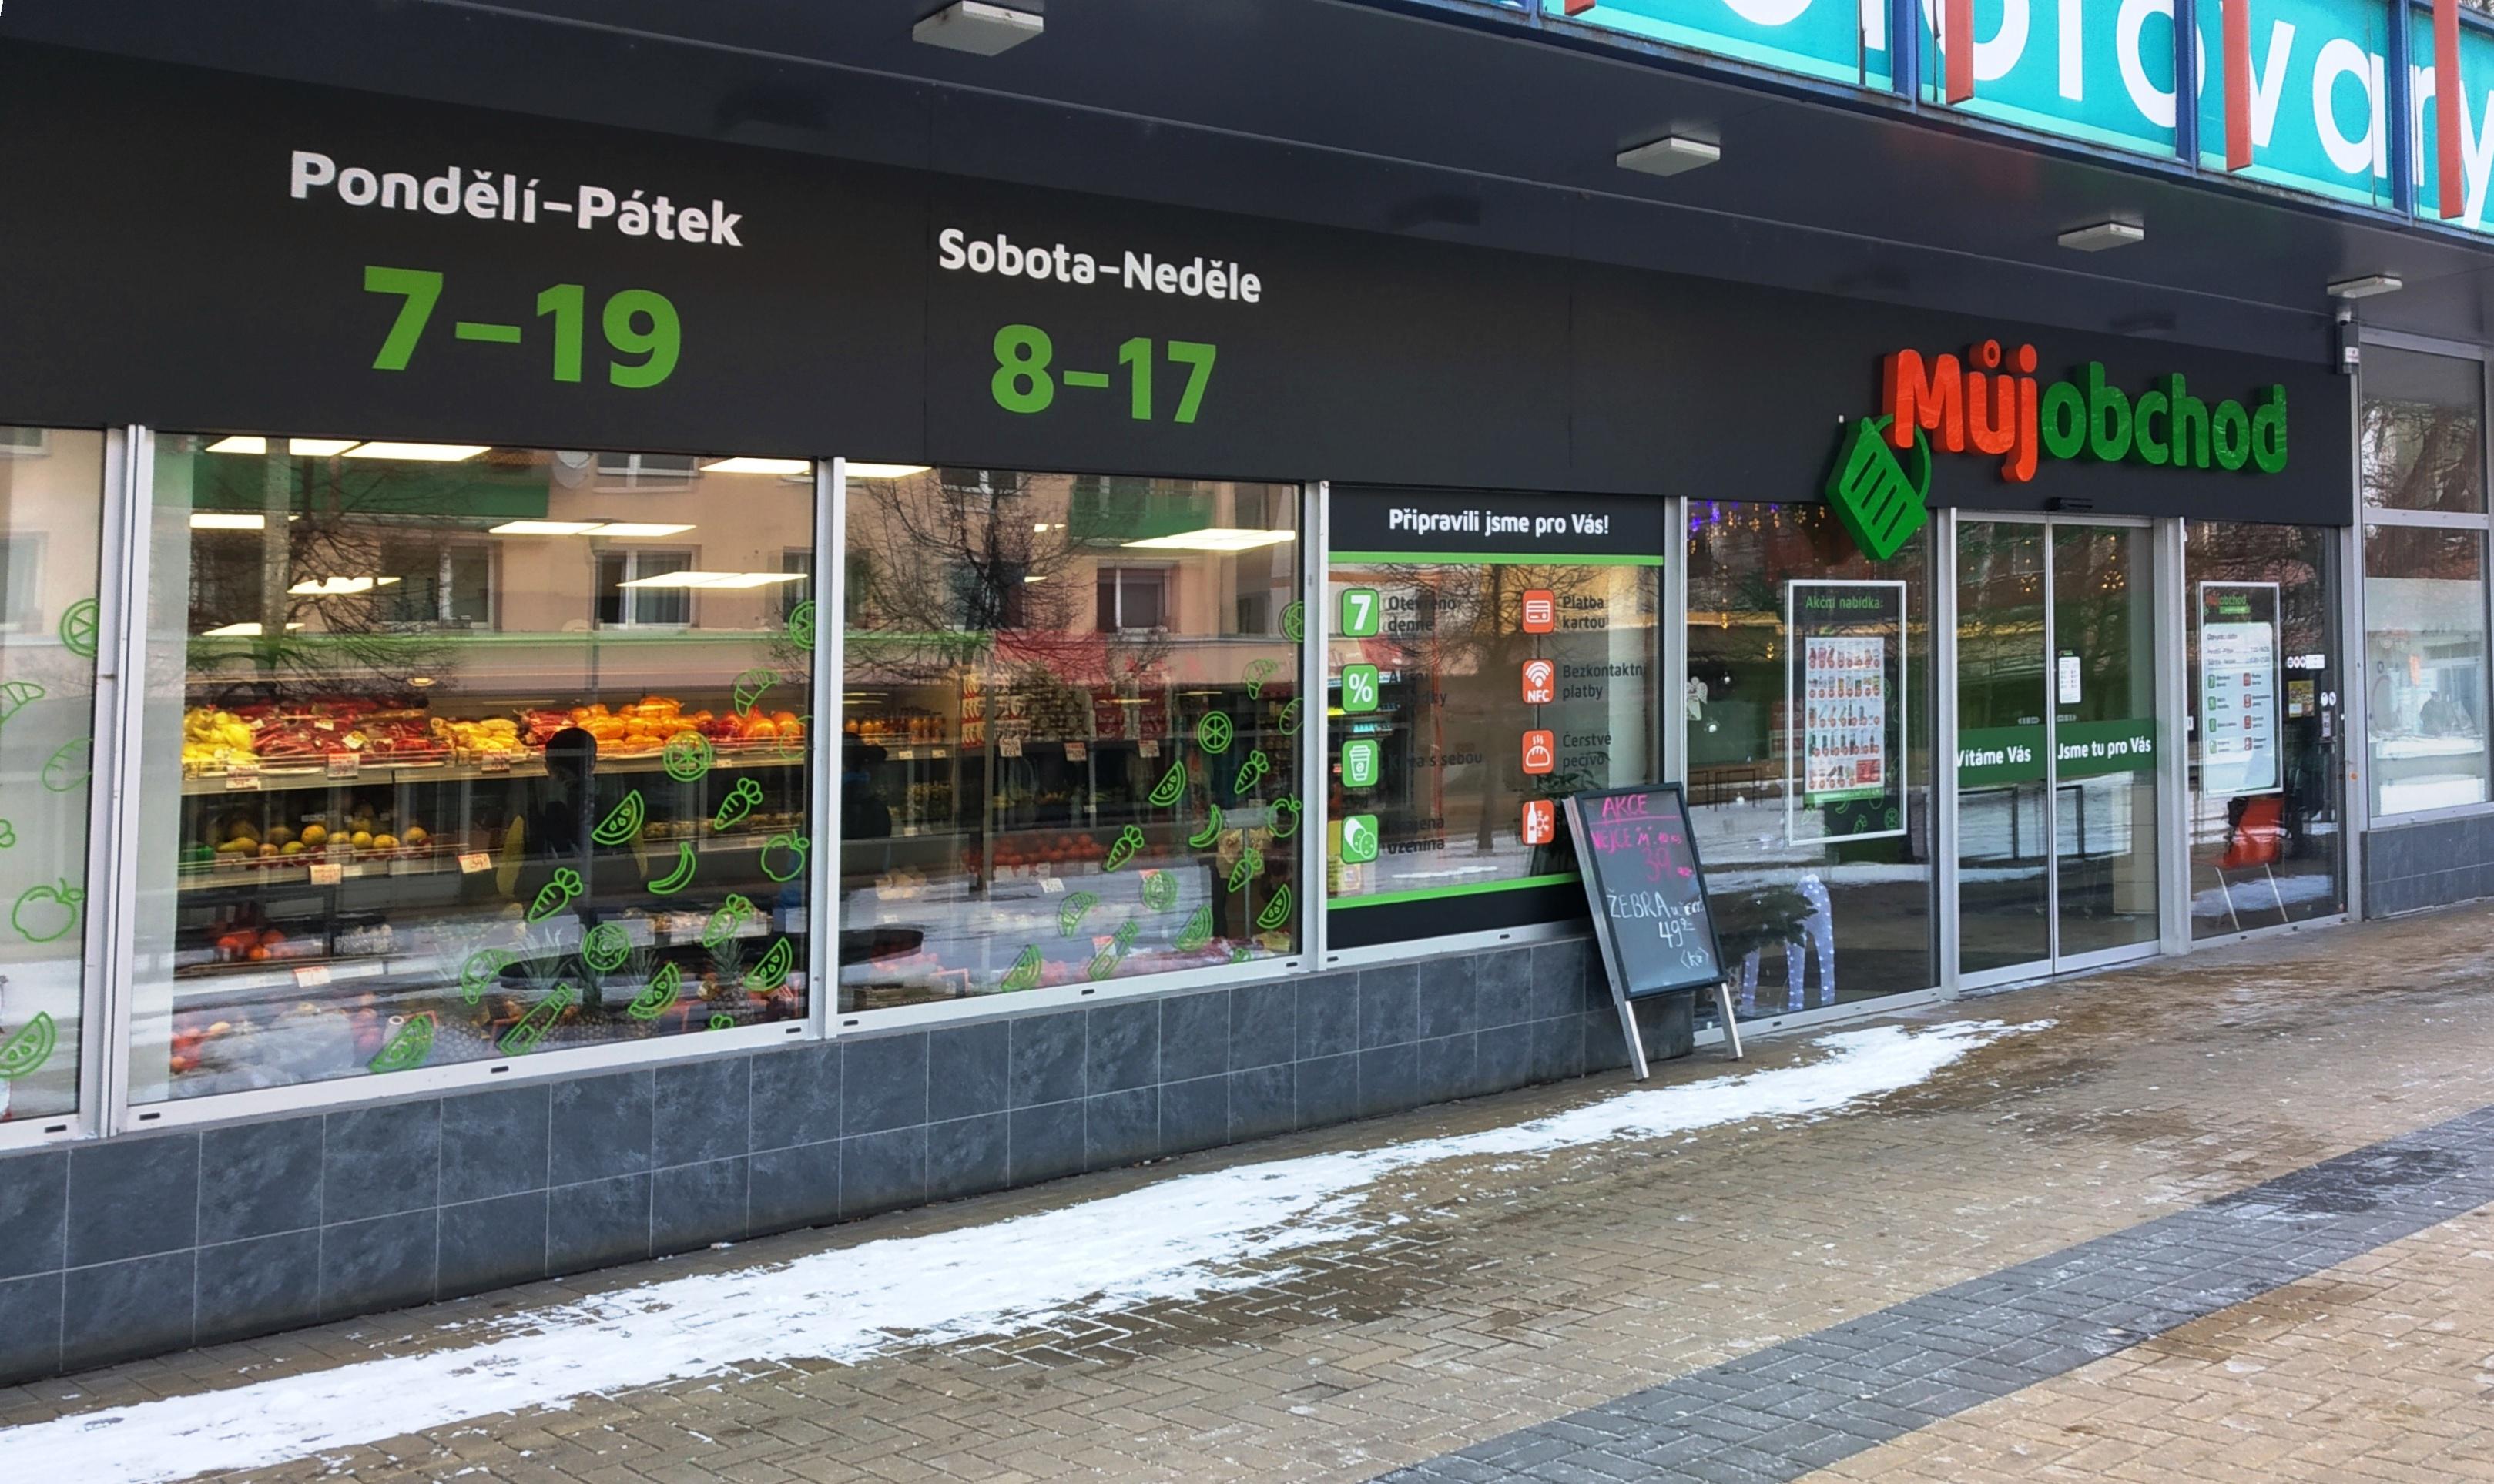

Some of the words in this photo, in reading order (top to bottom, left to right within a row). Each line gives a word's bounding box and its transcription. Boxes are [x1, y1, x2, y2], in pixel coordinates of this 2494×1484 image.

[1883, 339, 2037, 482] Můj
[2041, 361, 2288, 474] obchod
[1389, 508, 1479, 535] Připravili
[1485, 511, 1530, 537] jsme
[1535, 517, 1566, 538] pro
[1571, 514, 1609, 535] Vás!
[1350, 595, 1372, 631] 7
[1562, 595, 1604, 609] Platba
[1562, 615, 1605, 629] kartou
[1527, 689, 1550, 702] NFC
[1562, 684, 1603, 701] platby
[1441, 752, 1483, 765] sebou
[1956, 748, 2004, 768] Vítáme
[2006, 745, 2032, 764] Vás
[2057, 742, 2088, 761] Jsme
[2091, 740, 2104, 756] tu
[2107, 741, 2127, 759] pro
[2130, 735, 2151, 753] Vás
[1601, 794, 1648, 824] AKCE
[1606, 887, 1671, 919] ŽEBRA
